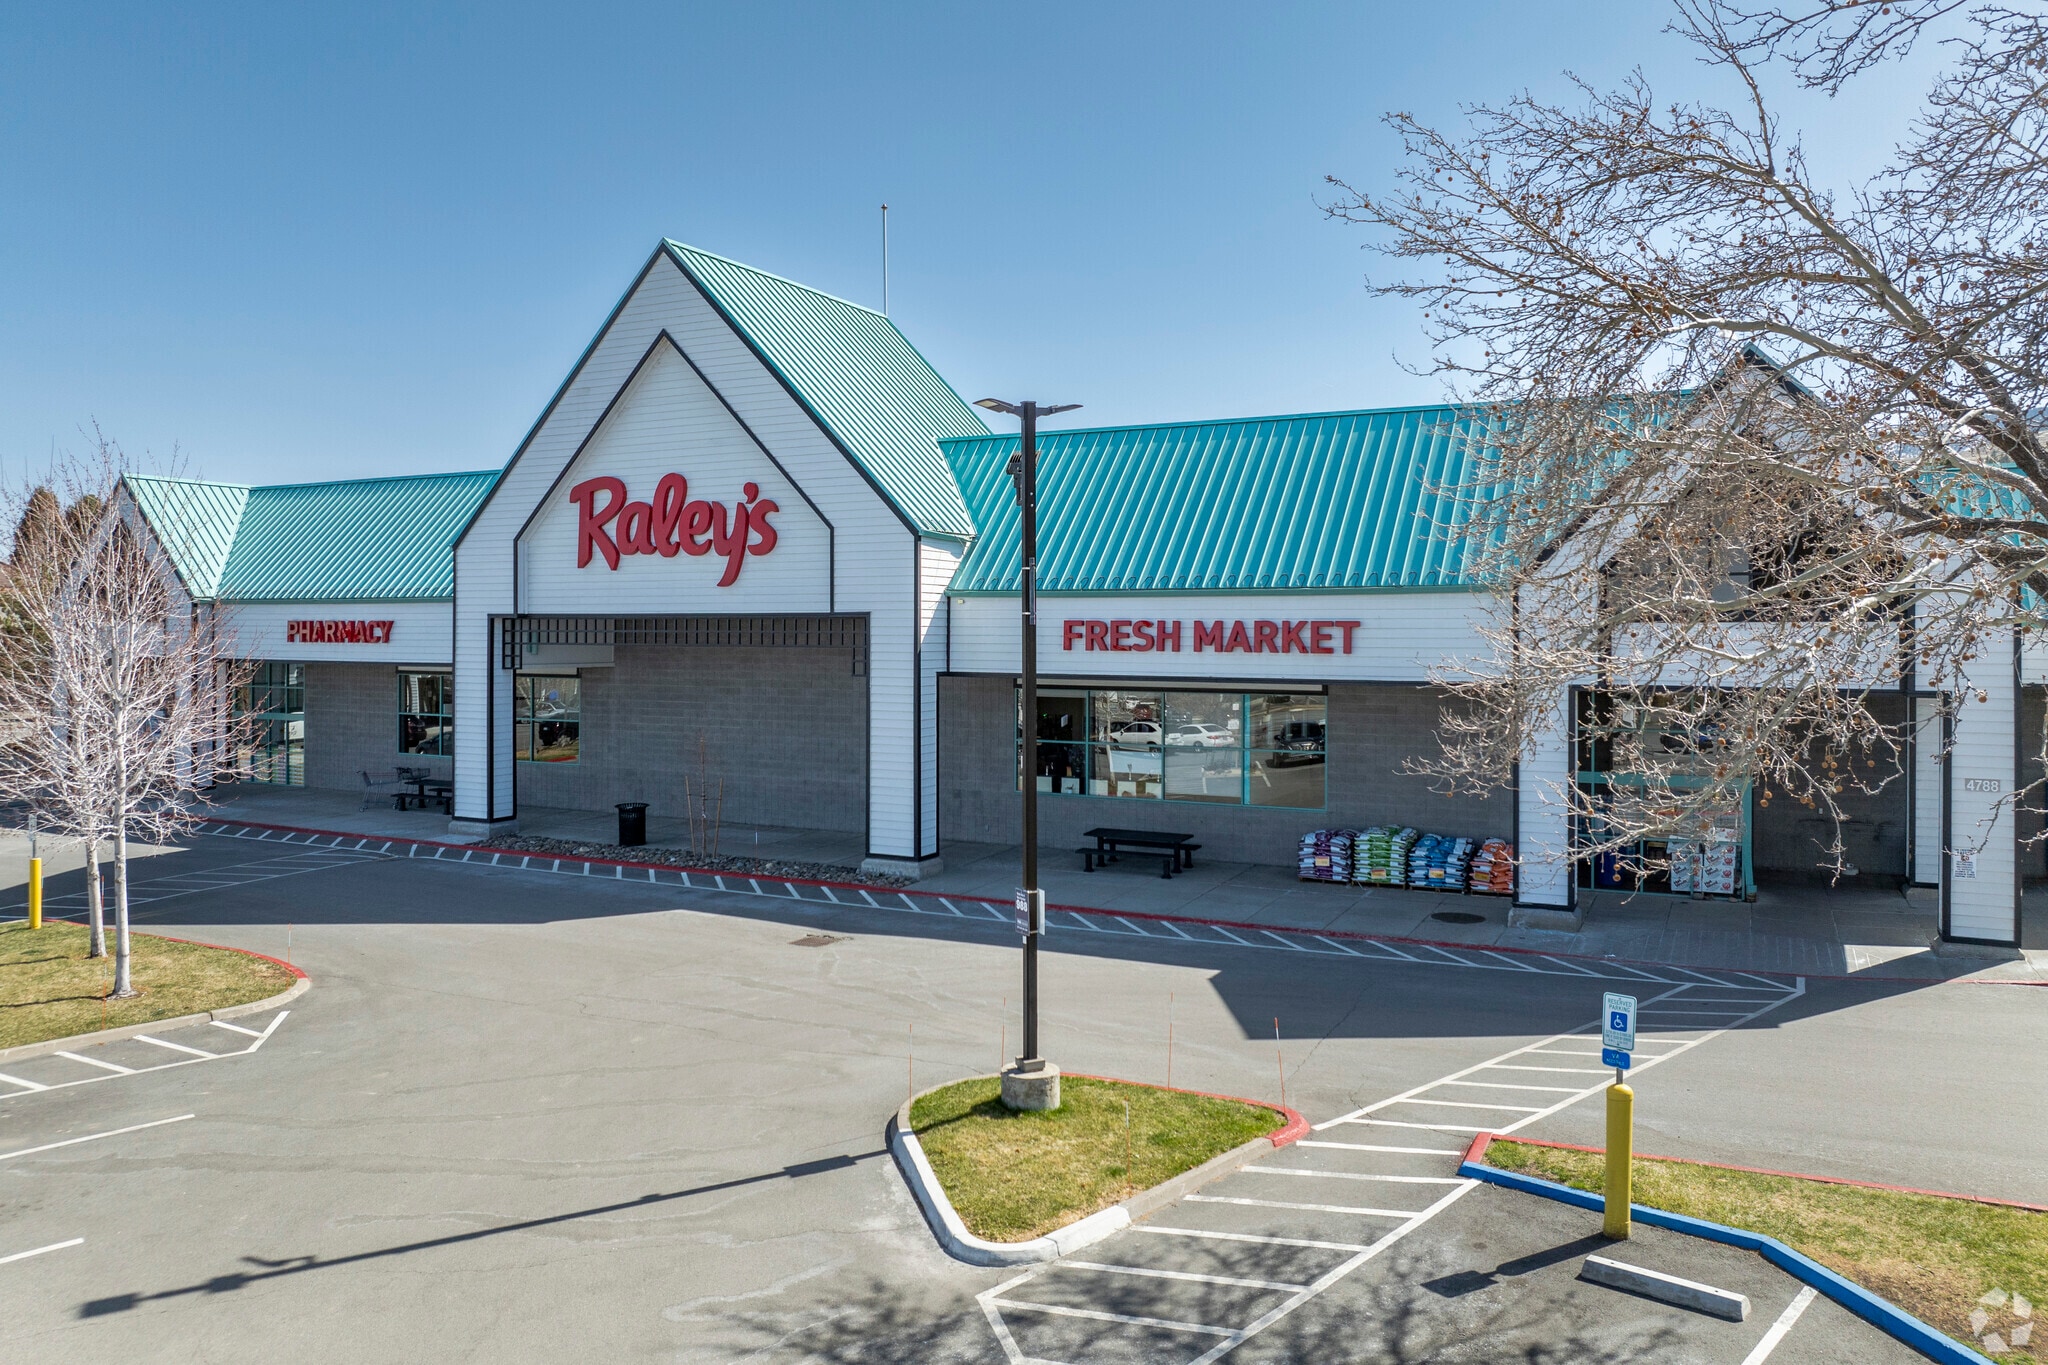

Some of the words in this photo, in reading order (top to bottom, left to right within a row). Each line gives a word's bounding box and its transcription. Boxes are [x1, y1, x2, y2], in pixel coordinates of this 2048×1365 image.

[569, 472, 780, 587] Raley's
[287, 620, 394, 643] PHARMACY
[1063, 619, 1181, 651] FRESH
[1194, 621, 1360, 654] MARKET
[1966, 779, 1999, 792] 4788
